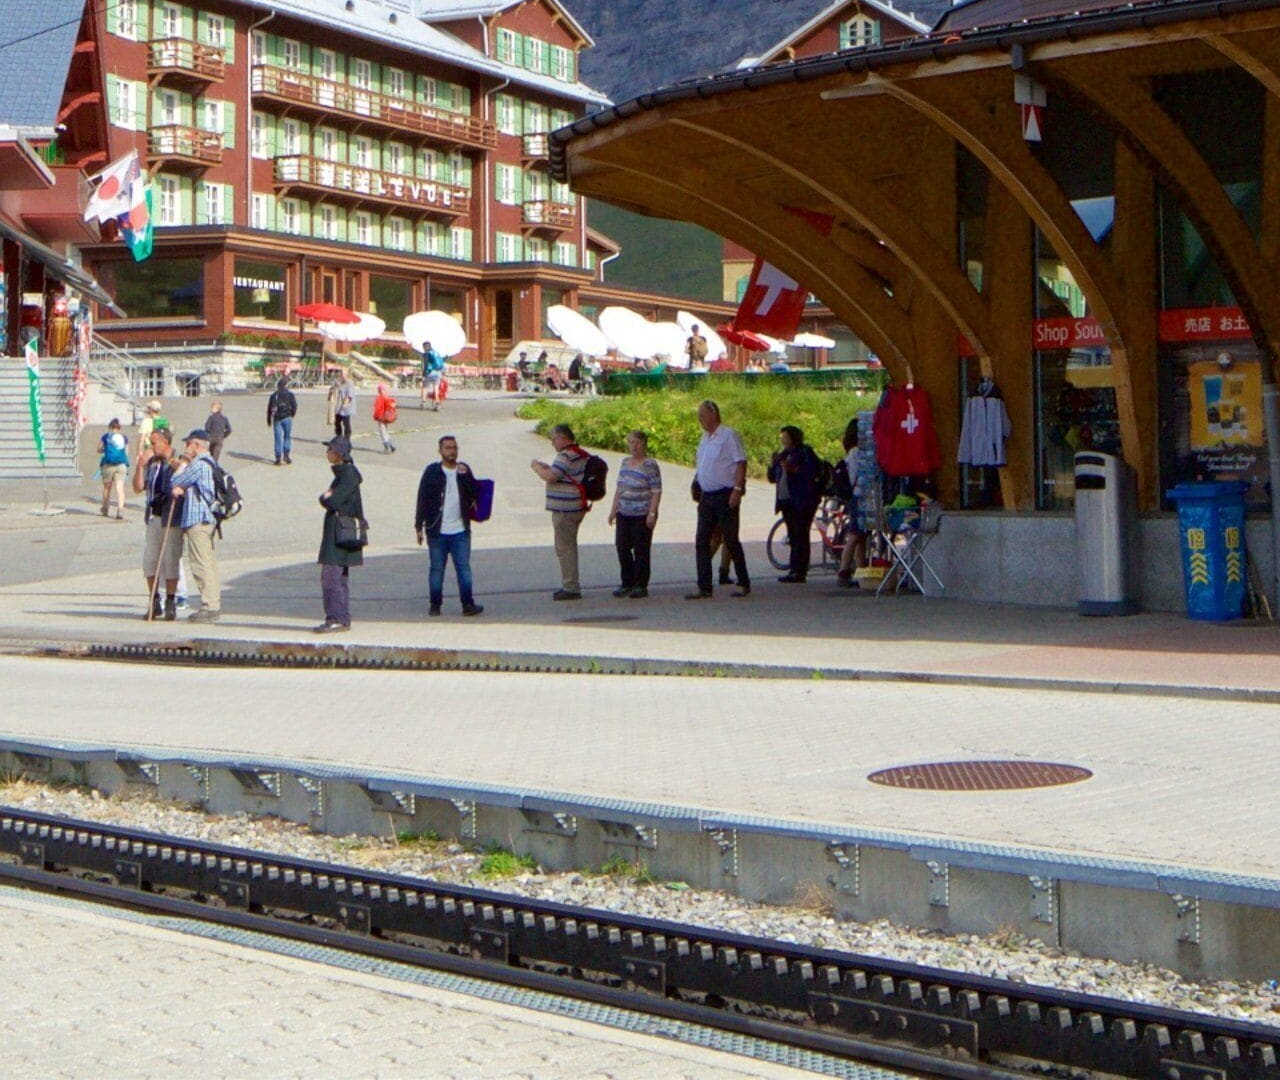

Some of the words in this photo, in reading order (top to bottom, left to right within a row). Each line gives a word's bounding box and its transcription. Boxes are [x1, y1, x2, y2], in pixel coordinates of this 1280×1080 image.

[1037, 323, 1068, 345] Shop
[1184, 318, 1211, 333] 売店
[1220, 316, 1251, 331] お土
